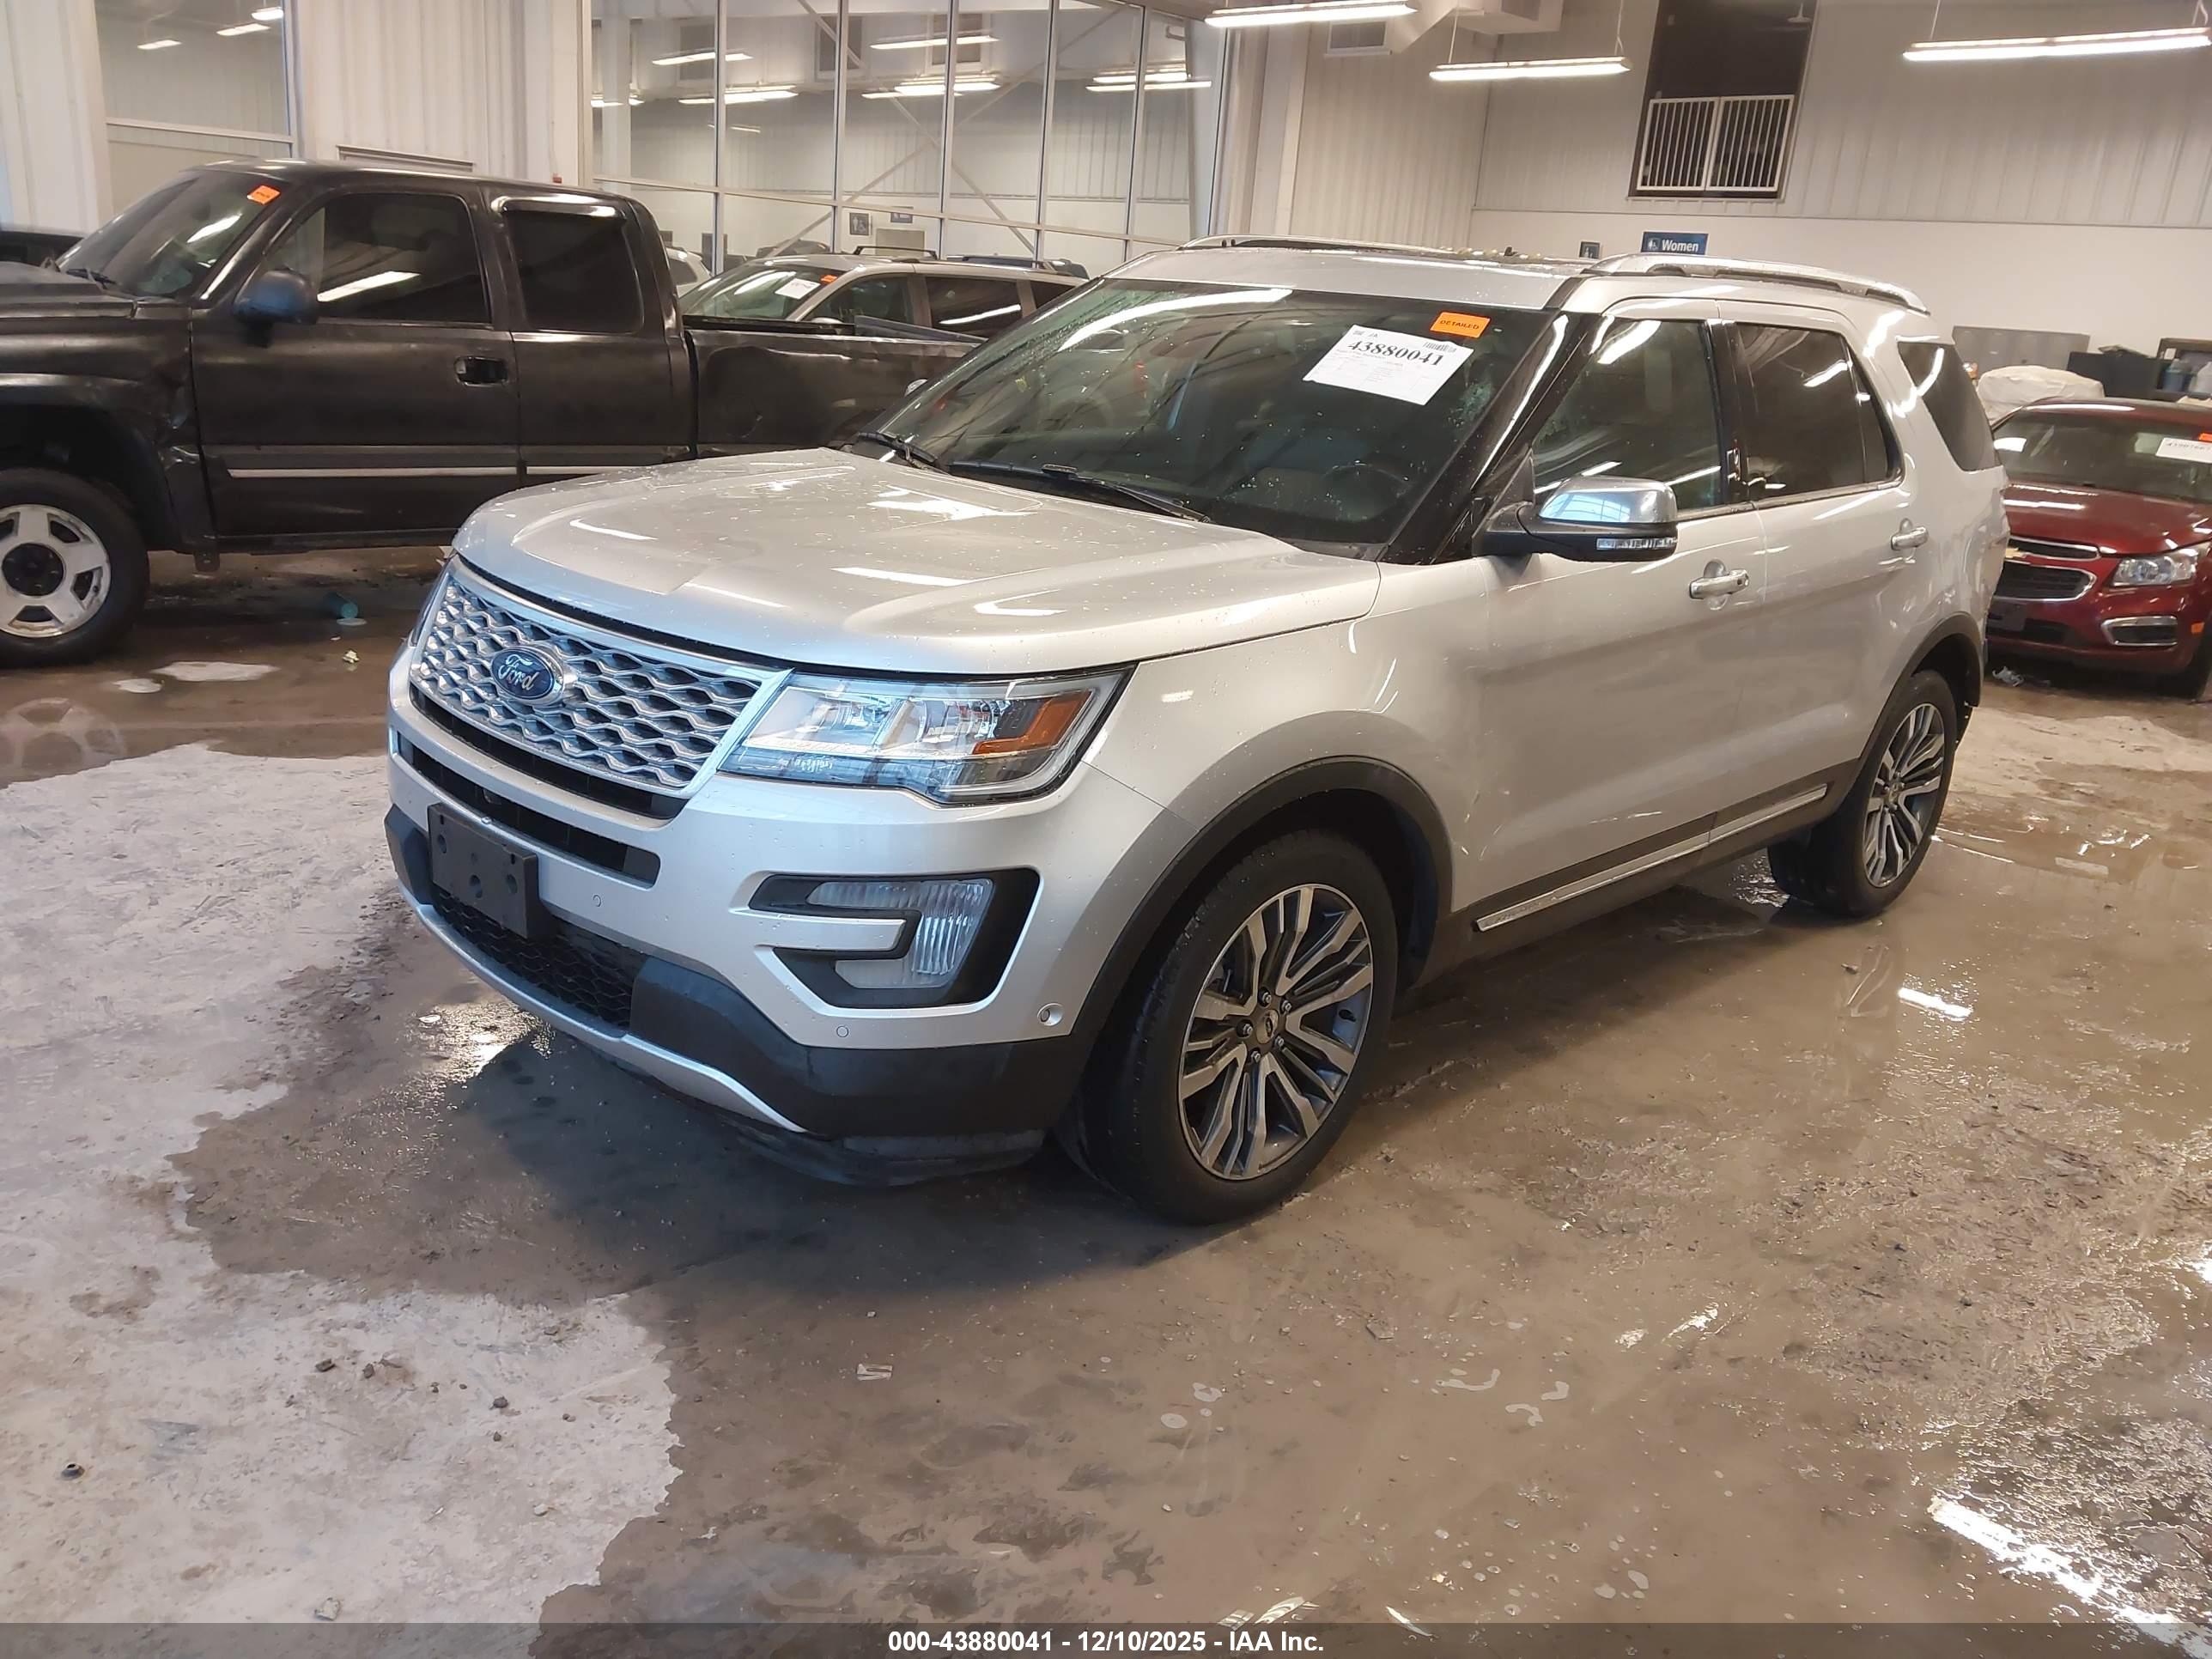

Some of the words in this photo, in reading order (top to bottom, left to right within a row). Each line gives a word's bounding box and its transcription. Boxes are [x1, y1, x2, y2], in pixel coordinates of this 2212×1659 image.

[1662, 240, 1698, 252] Women
[1440, 319, 1480, 330] DETAILED
[1347, 340, 1443, 366] 43880041
[499, 654, 540, 690] Ford
